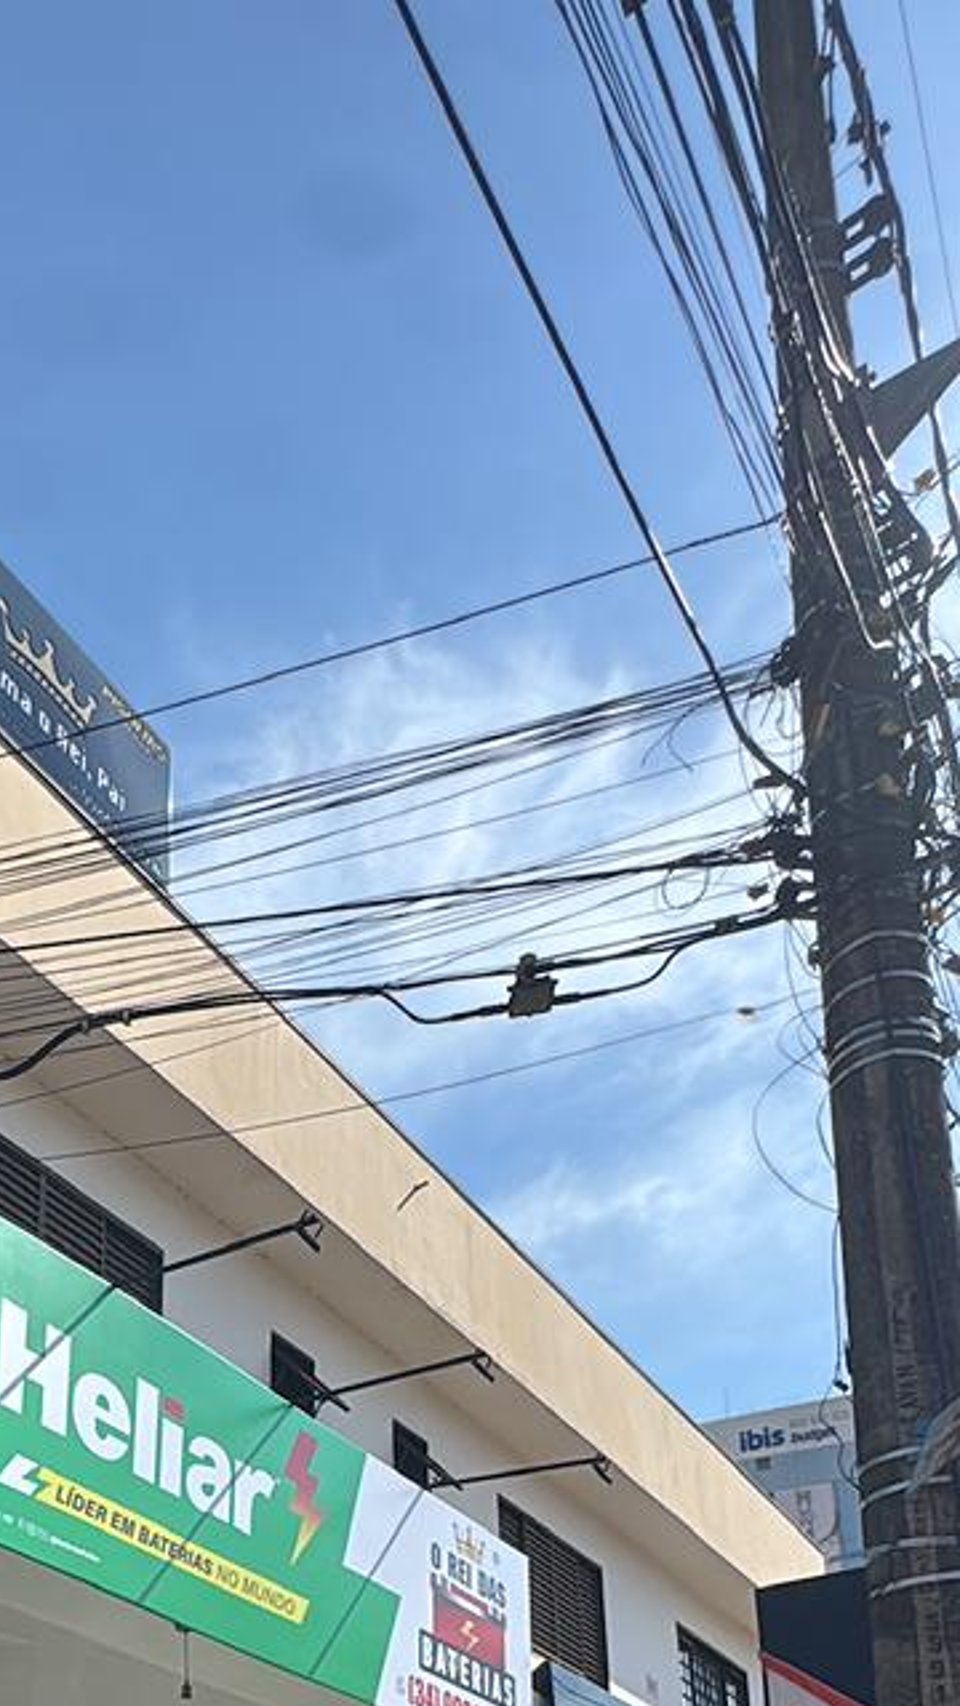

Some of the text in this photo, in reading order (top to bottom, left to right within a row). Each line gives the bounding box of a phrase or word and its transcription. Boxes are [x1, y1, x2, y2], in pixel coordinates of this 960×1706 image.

[97, 766, 126, 812] Pai
[55, 1486, 107, 1523] LÍDER
[111, 1512, 137, 1537] EM
[138, 1525, 214, 1574] BATERIAS
[216, 1564, 240, 1589] NO
[241, 1576, 297, 1615] MUNDO
[430, 1541, 507, 1609] O REI DAS
